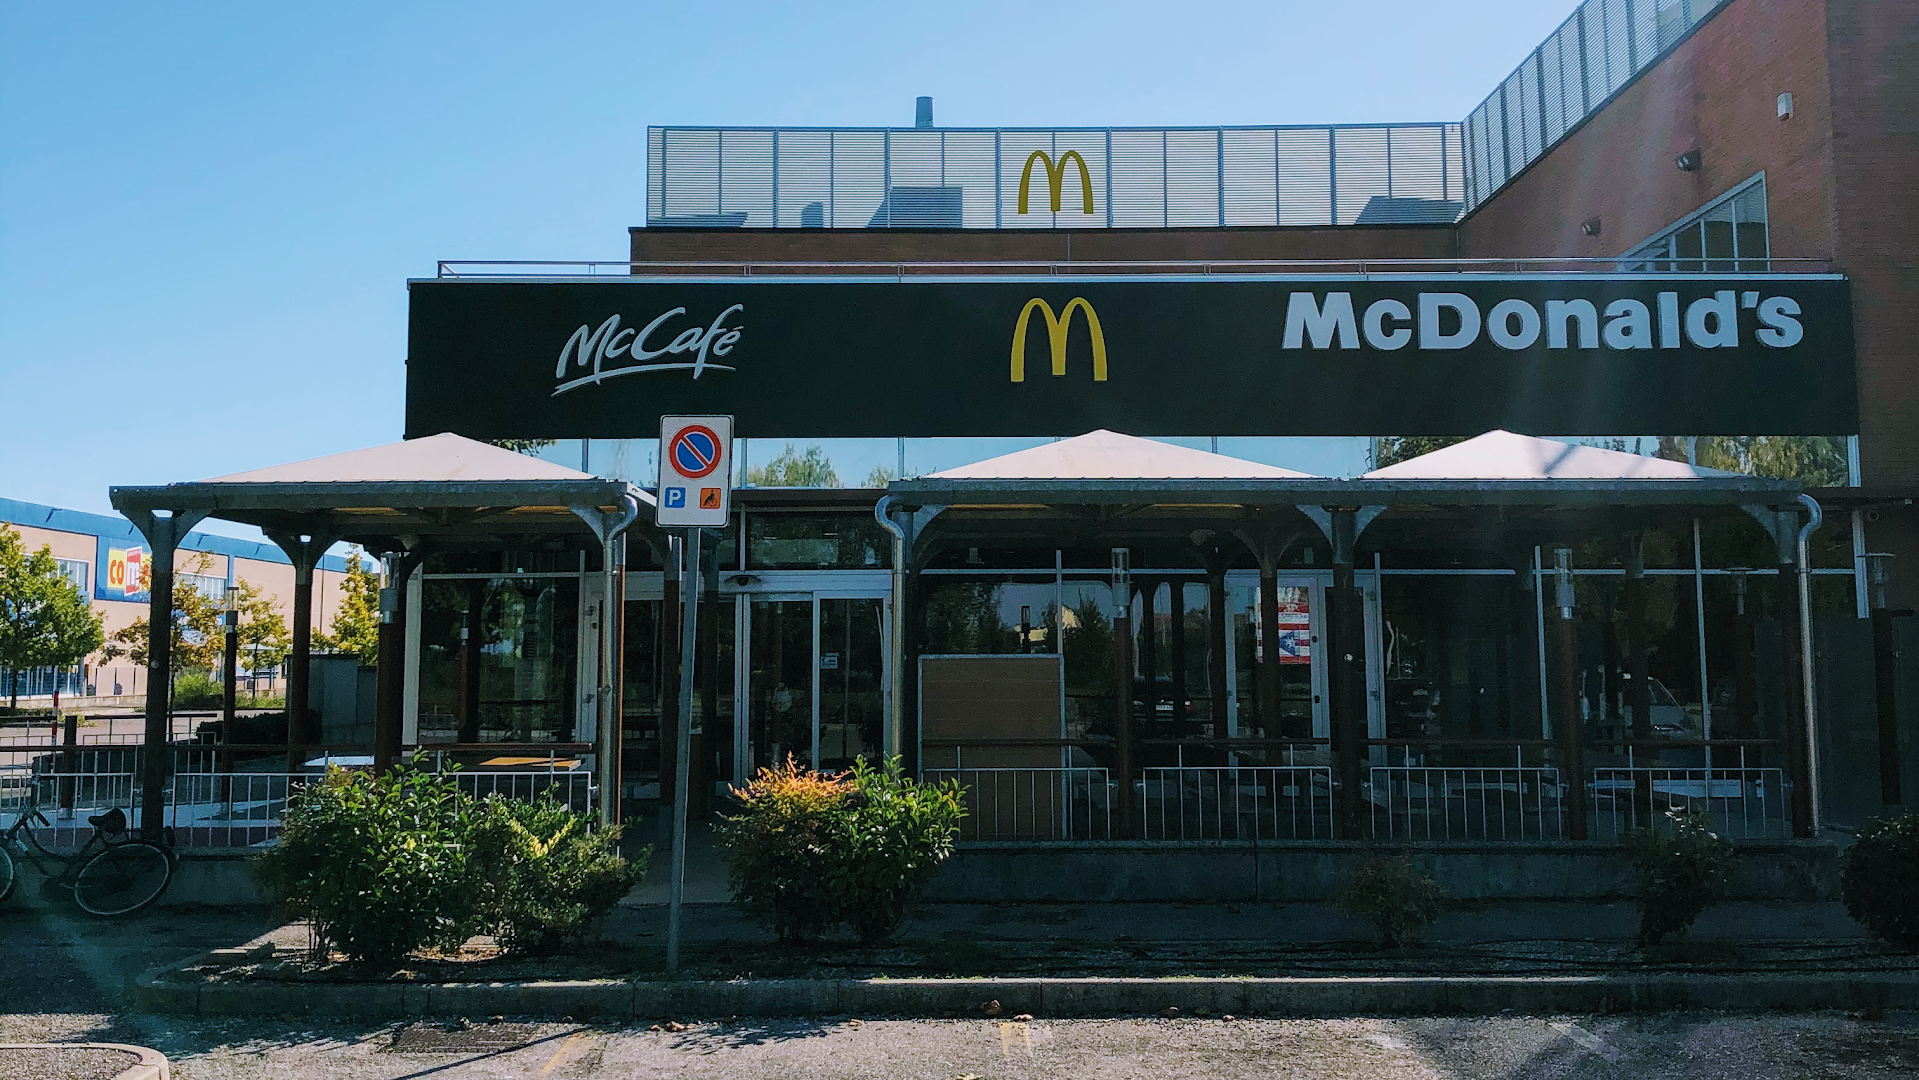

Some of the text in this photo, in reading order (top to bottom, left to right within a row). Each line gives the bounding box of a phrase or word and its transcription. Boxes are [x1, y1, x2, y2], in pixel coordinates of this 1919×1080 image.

[555, 303, 744, 386] McCafé
[1281, 290, 1804, 350] McDonald's
[668, 489, 682, 506] P
